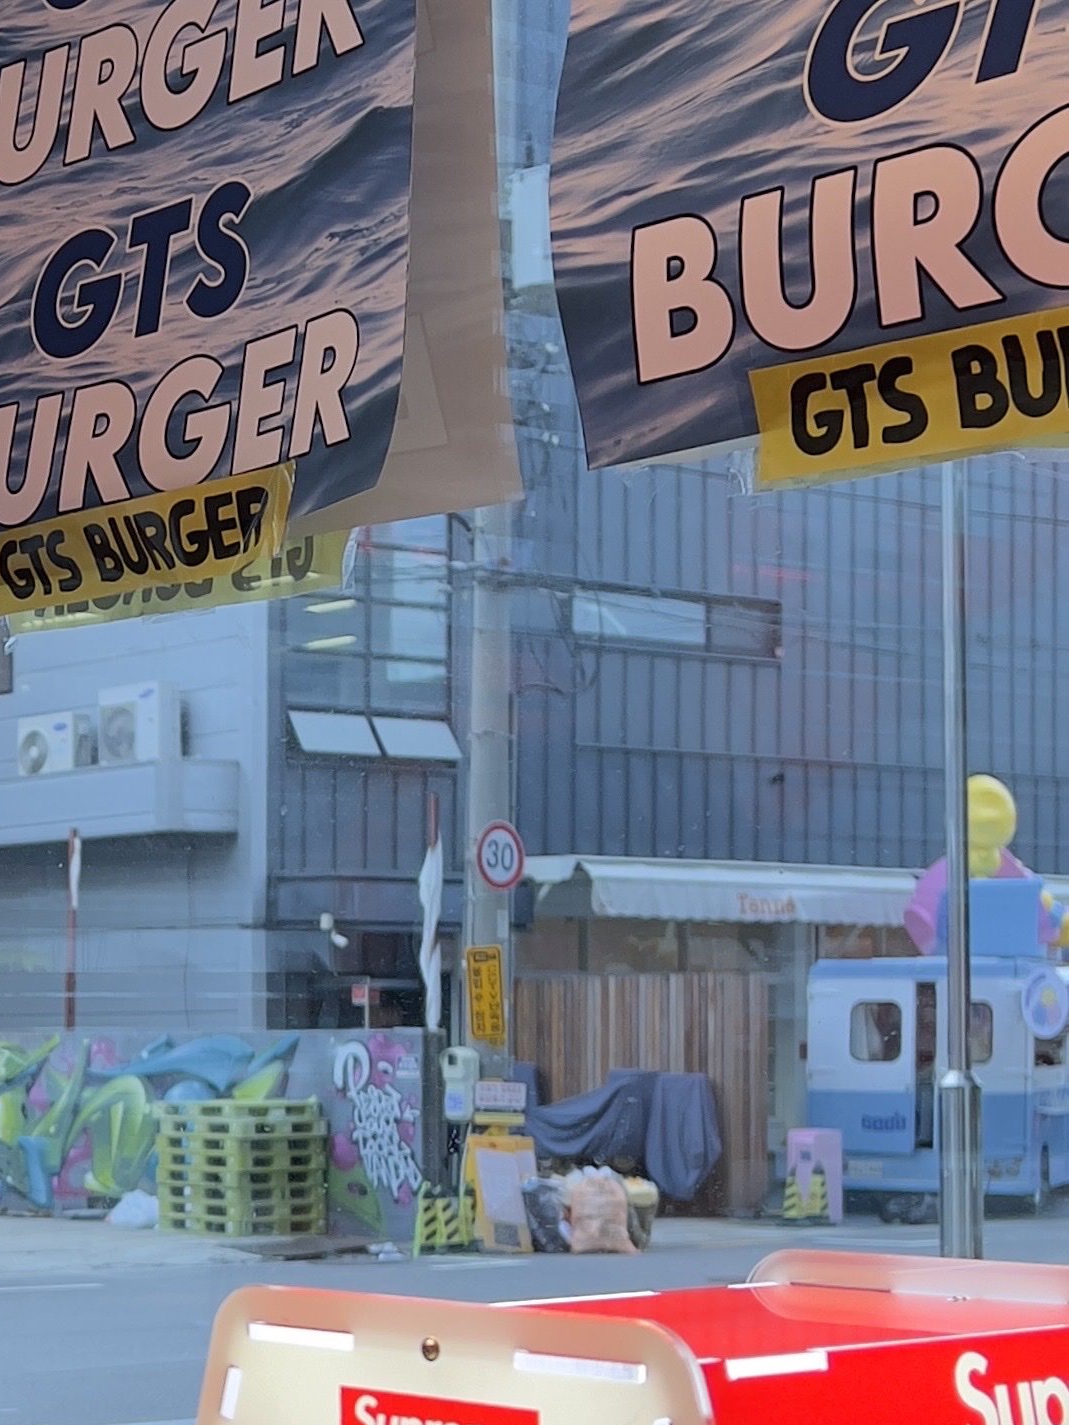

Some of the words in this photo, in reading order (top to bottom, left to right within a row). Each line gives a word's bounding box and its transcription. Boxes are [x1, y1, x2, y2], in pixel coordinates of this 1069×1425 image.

[32, 179, 252, 360] GTS
[790, 356, 929, 456] GTS
[951, 325, 1069, 430] BU
[0, 529, 83, 600] GTS
[84, 486, 269, 583] BURGER
[487, 840, 514, 871] 30
